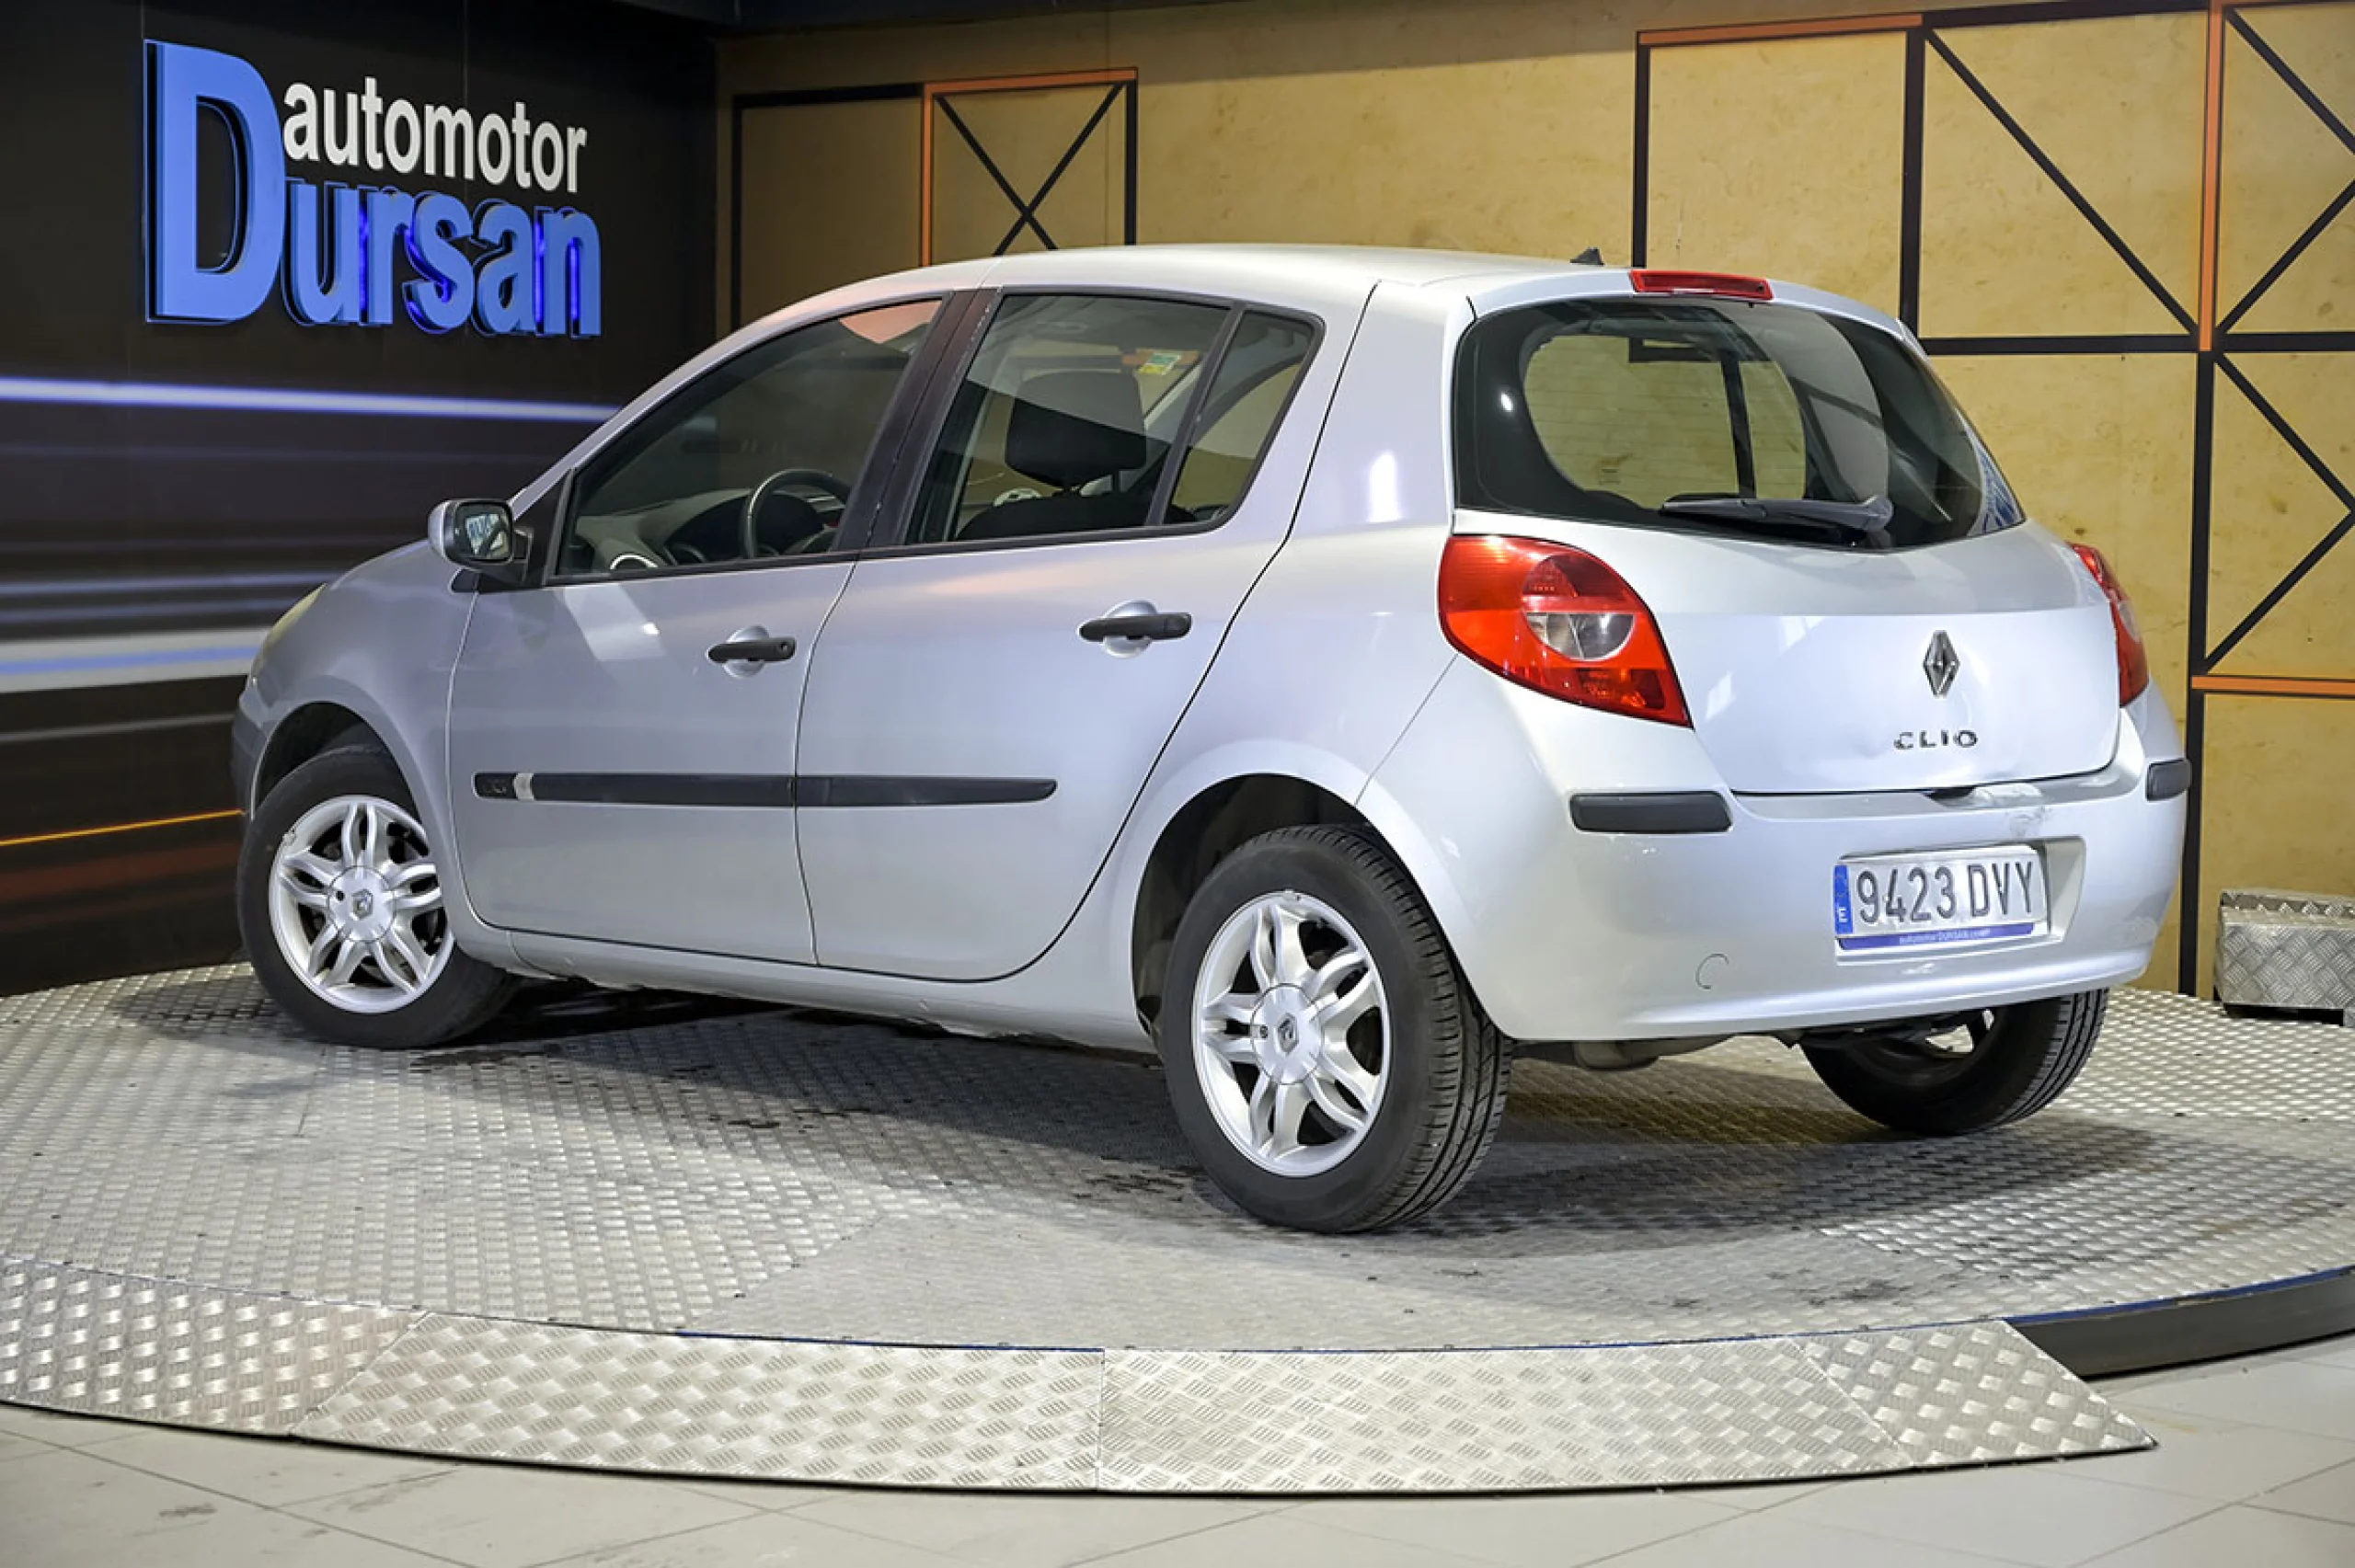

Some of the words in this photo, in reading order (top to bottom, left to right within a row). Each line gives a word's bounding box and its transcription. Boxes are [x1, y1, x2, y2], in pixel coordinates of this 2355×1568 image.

[283, 77, 587, 192] automotor
[144, 39, 601, 338] Dursan
[1894, 729, 1978, 750] CLIO
[1838, 907, 1848, 923] E
[1855, 866, 1957, 924] 9423
[1968, 861, 2033, 917] DVY
